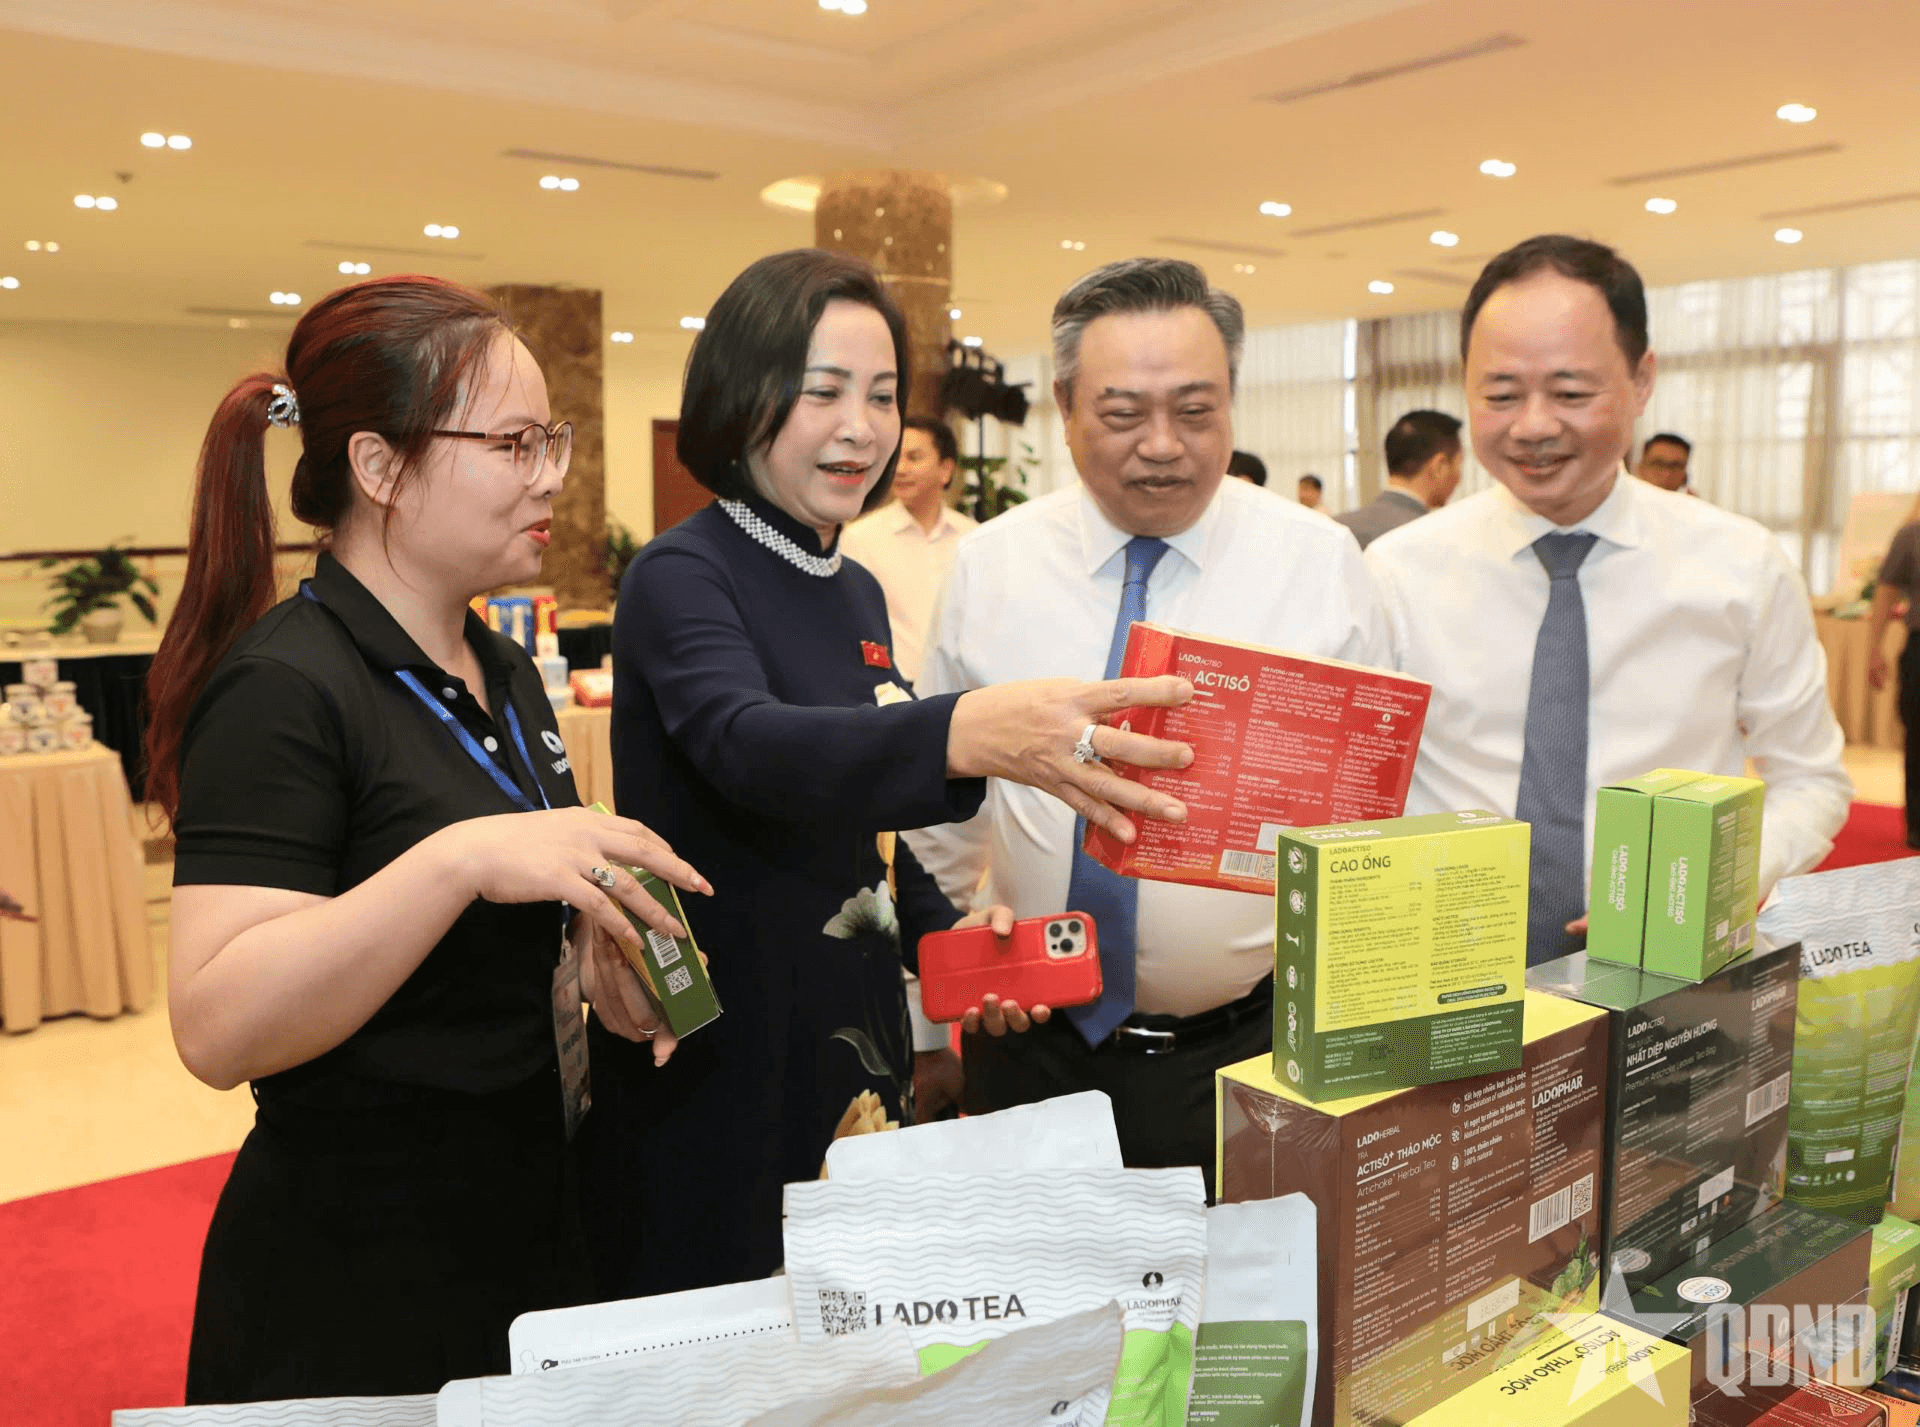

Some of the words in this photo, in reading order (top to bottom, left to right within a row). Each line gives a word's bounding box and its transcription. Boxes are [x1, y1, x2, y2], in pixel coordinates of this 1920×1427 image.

[1194, 670, 1250, 691] ACTISÔ
[1330, 859, 1359, 874] CAO
[1362, 853, 1391, 870] ỐNG
[1843, 941, 1872, 959] TEA
[1532, 1075, 1583, 1109] LADOPHAR
[1397, 1142, 1420, 1160] THẢO
[1421, 1133, 1442, 1150] MỘC
[1397, 1163, 1422, 1182] Herbal
[1423, 1159, 1436, 1169] Tea
[962, 1294, 1026, 1320] TEA
[1532, 1356, 1572, 1377] THẢO
[1500, 1375, 1538, 1395] MỘC
